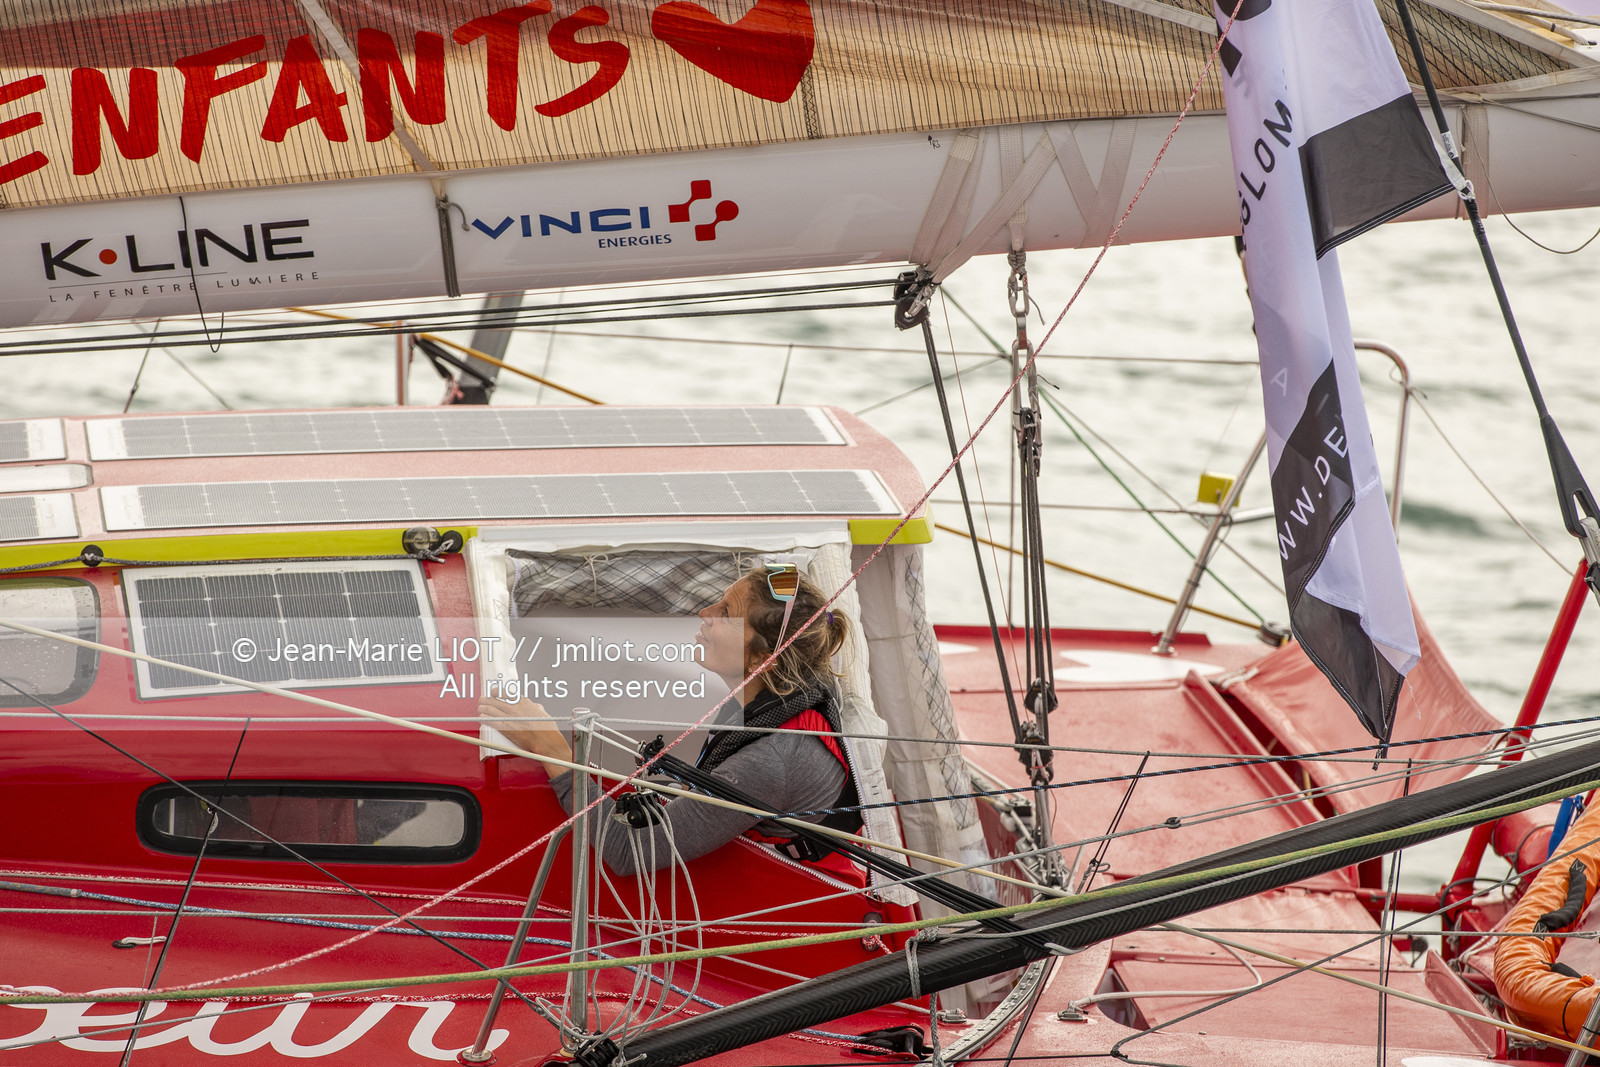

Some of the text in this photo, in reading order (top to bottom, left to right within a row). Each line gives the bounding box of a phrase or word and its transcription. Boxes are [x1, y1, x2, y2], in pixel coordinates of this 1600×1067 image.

[0, 0, 631, 185] ENFANTS
[471, 206, 651, 240] VINCI
[598, 233, 672, 249] ENERGIES
[49, 292, 75, 303] LA
[216, 271, 319, 289] LUMIERE
